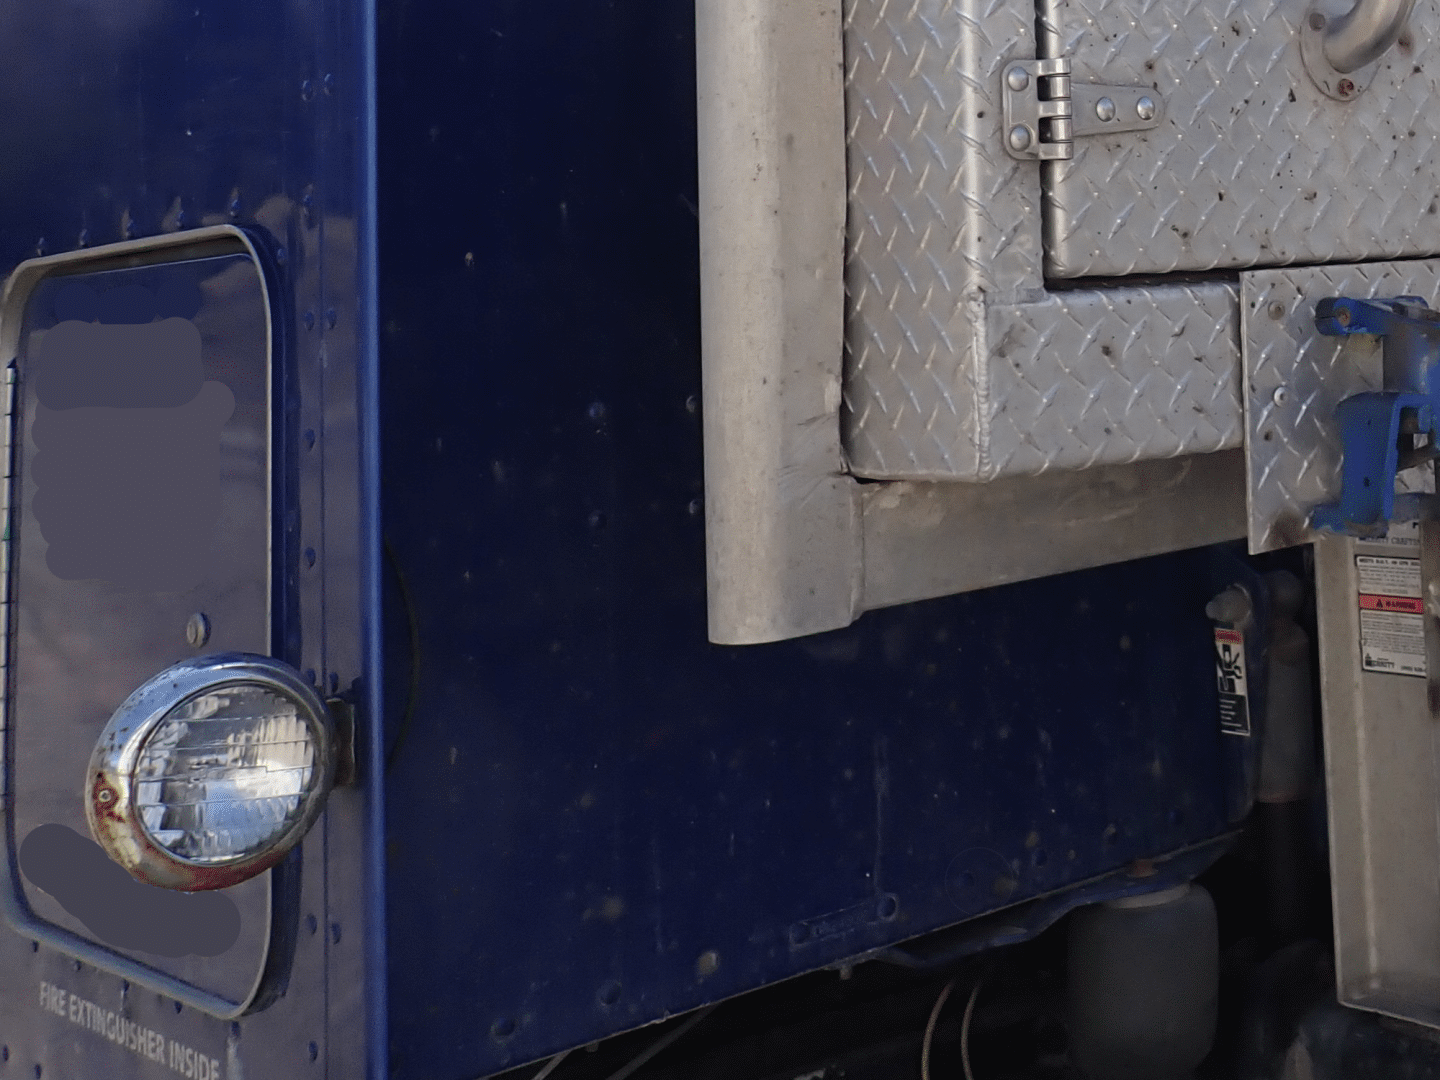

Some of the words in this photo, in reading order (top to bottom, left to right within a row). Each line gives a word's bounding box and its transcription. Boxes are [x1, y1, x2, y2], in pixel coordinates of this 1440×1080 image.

[39, 981, 67, 1017] FIRE
[69, 994, 165, 1065] EXTINGUISHER
[170, 1040, 219, 1080] INSIDE
